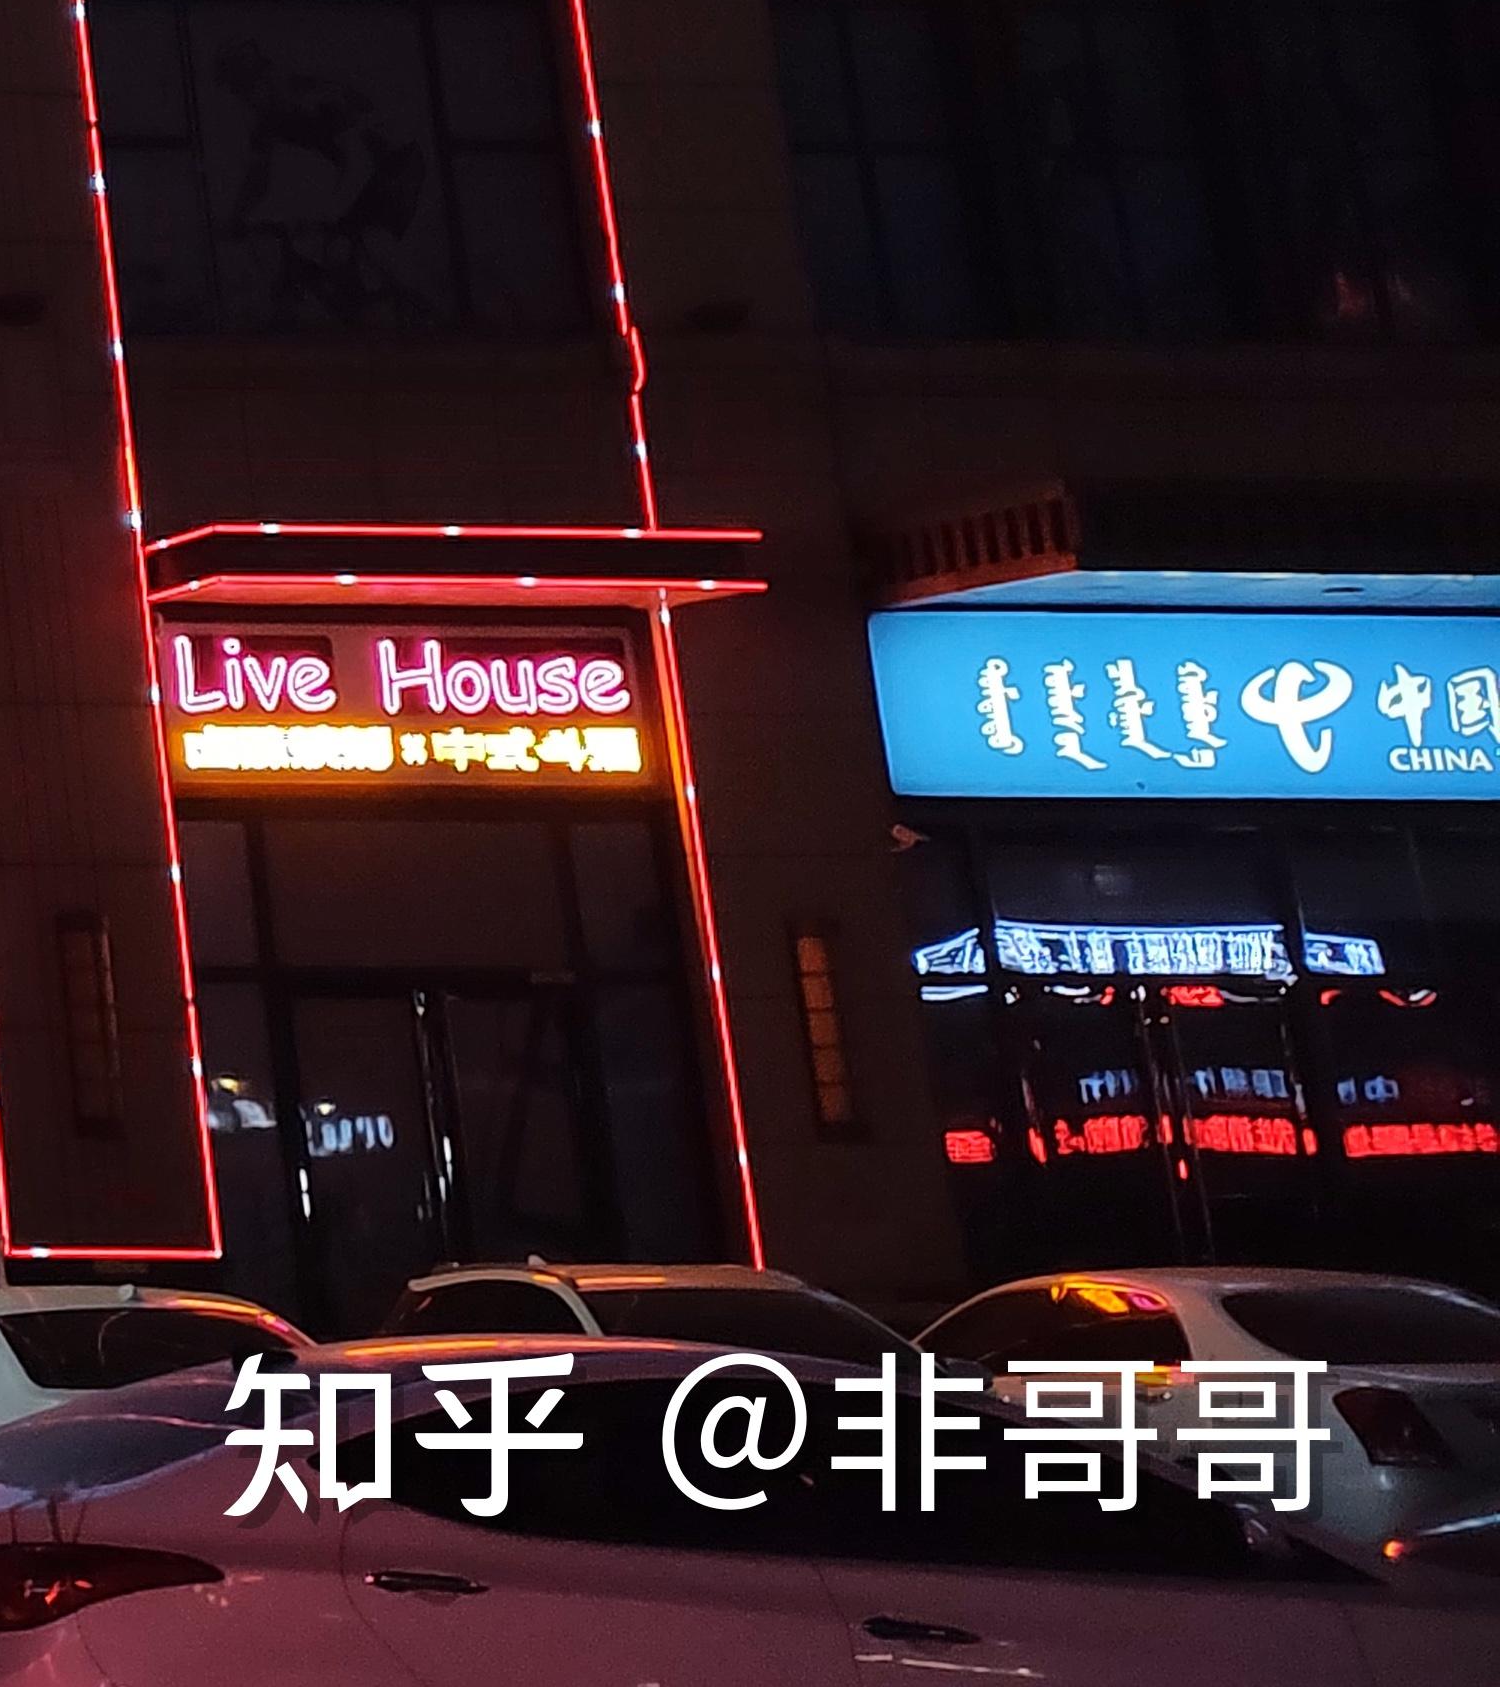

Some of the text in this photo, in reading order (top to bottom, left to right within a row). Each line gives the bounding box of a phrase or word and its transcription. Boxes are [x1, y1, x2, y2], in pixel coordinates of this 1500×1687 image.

[173, 634, 630, 715] Live House
[1388, 746, 1495, 772] CHINA
